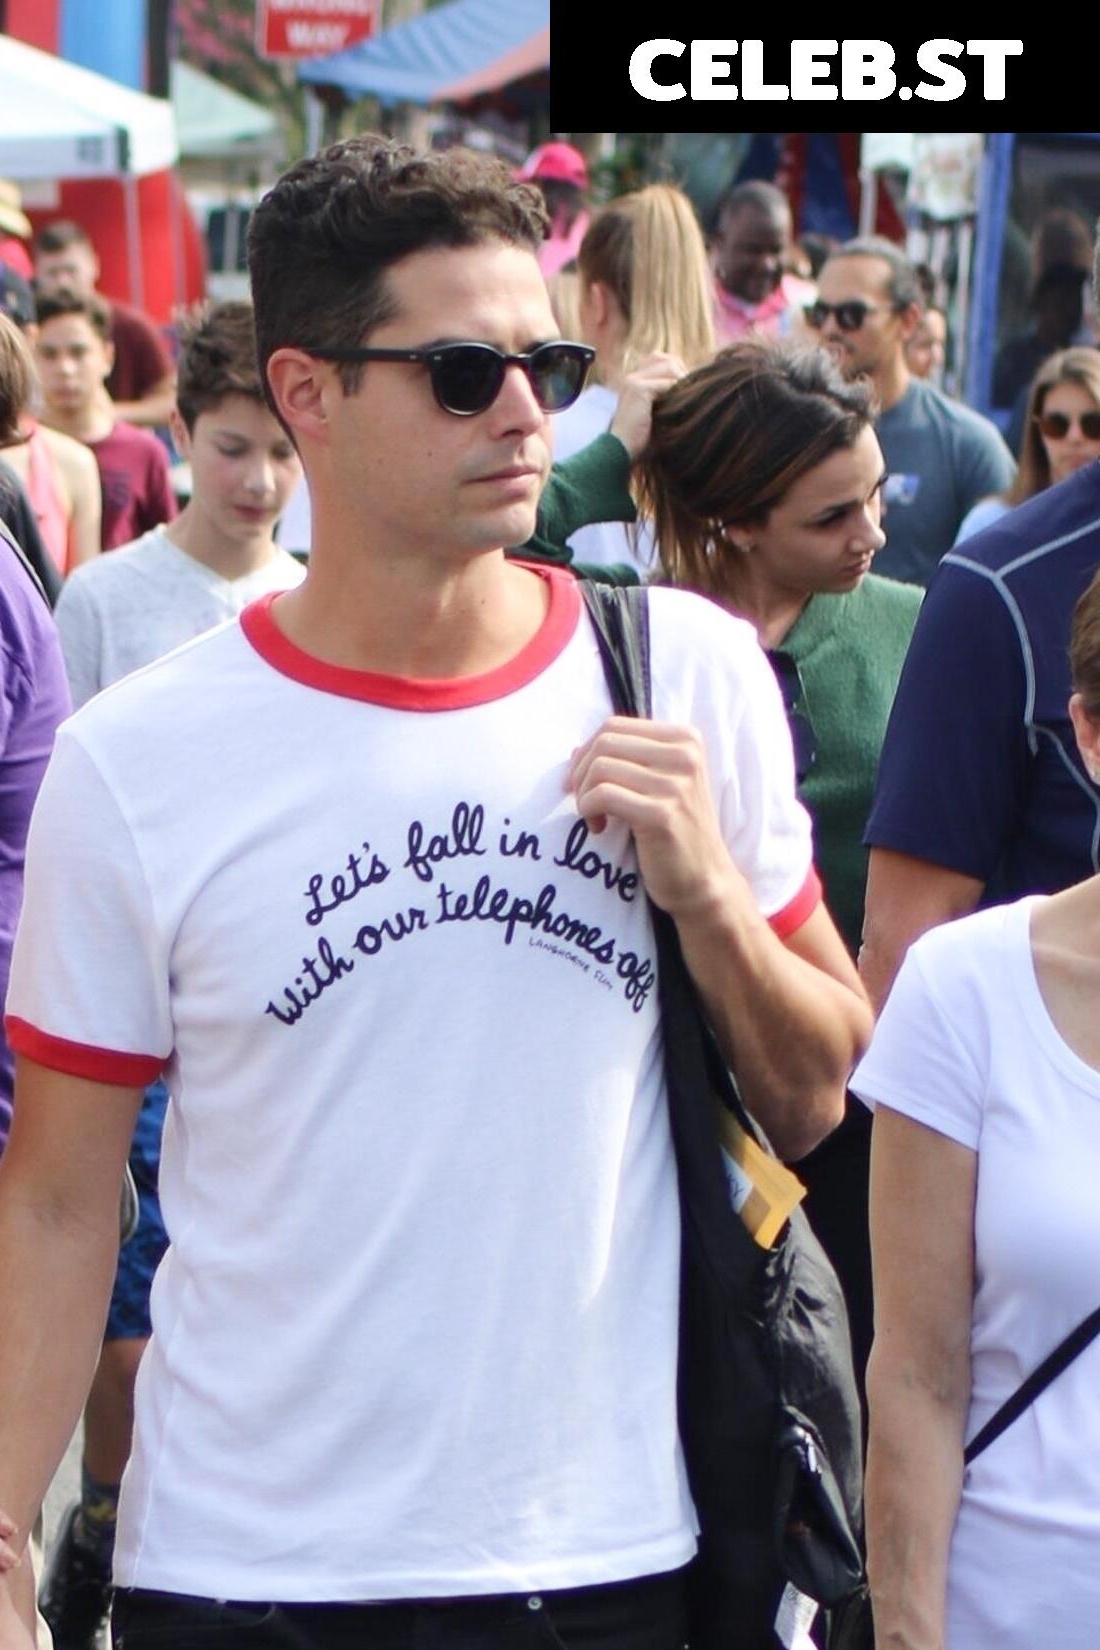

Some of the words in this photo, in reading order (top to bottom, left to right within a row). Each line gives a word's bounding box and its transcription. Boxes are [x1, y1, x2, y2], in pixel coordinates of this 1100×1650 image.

[303, 841, 391, 927] Let's
[403, 800, 487, 883] fall
[499, 817, 542, 861] in
[554, 818, 639, 903] love
[352, 907, 429, 956] our
[436, 874, 616, 965] telephones
[617, 951, 656, 1014] off
